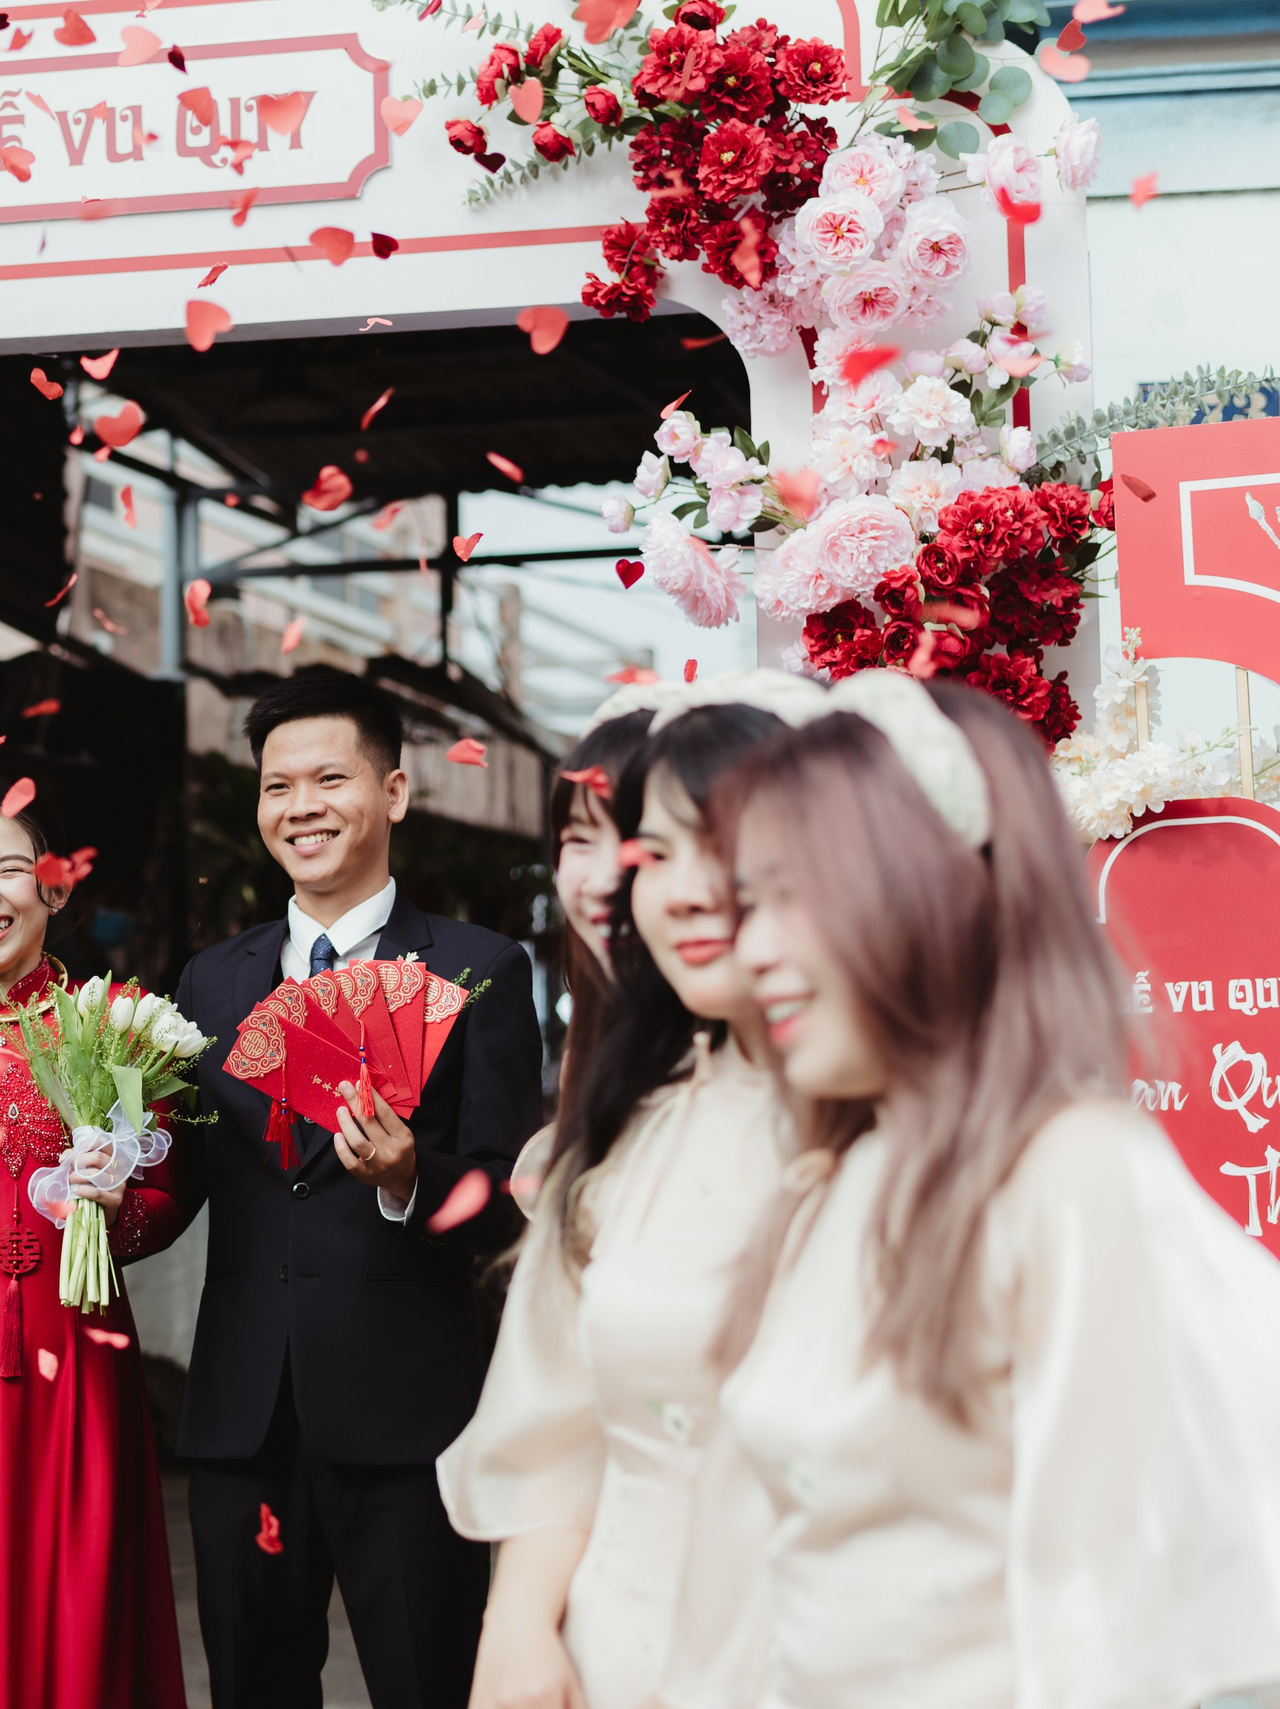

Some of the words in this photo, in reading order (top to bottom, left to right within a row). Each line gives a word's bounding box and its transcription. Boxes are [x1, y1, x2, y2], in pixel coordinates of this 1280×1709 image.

[55, 105, 144, 167] VU
[1165, 980, 1215, 1013] VU
[1228, 977, 1280, 1016] QU
